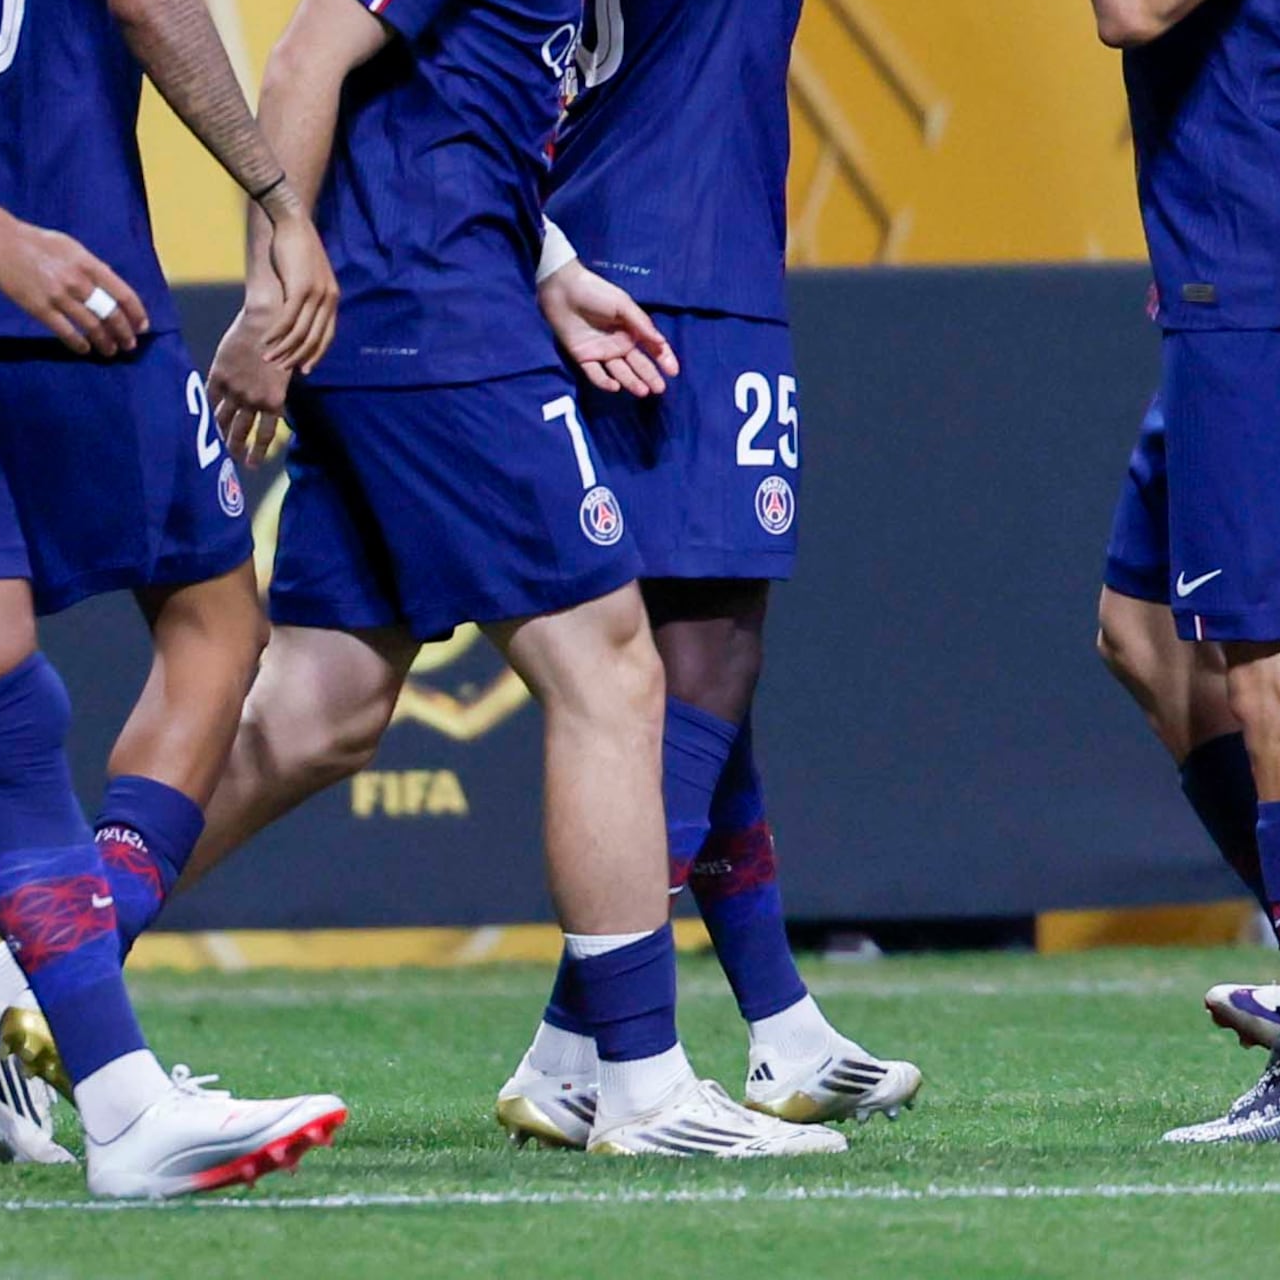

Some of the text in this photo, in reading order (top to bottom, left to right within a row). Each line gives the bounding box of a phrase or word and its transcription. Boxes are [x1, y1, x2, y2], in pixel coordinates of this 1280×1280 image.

[186, 370, 223, 469] 2
[542, 395, 596, 490] 7
[734, 372, 798, 469] 25
[350, 769, 468, 817] FIFA
